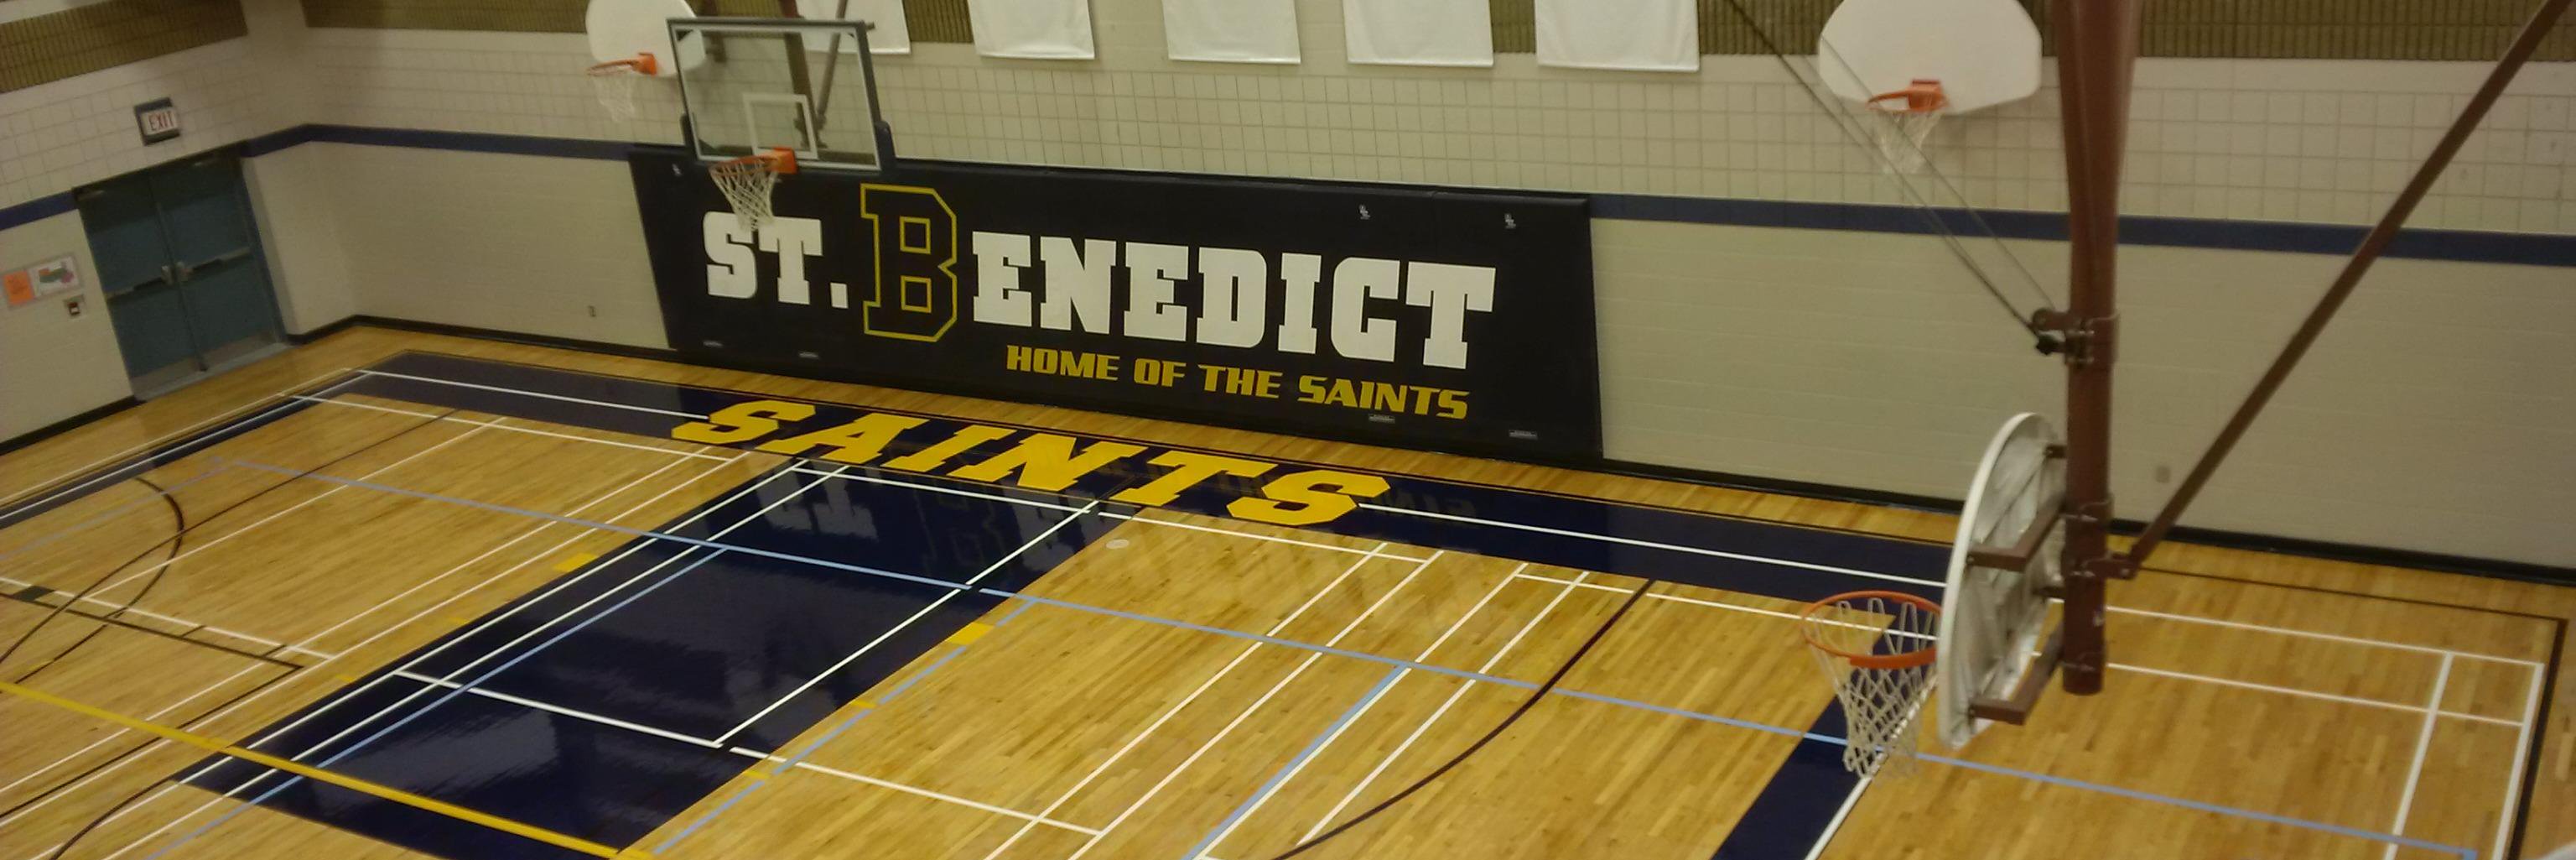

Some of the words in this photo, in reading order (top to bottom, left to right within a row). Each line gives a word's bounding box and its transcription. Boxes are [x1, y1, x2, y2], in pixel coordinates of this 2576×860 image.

[148, 109, 174, 132] EXIT
[702, 210, 849, 310] ST.
[860, 182, 1498, 371] BENEDICT
[1006, 343, 1120, 382] HOME
[1133, 357, 1186, 388] OF
[1197, 362, 1283, 400] THE
[1297, 374, 1471, 421] SAINTS
[670, 398, 1392, 527] SAINTS
